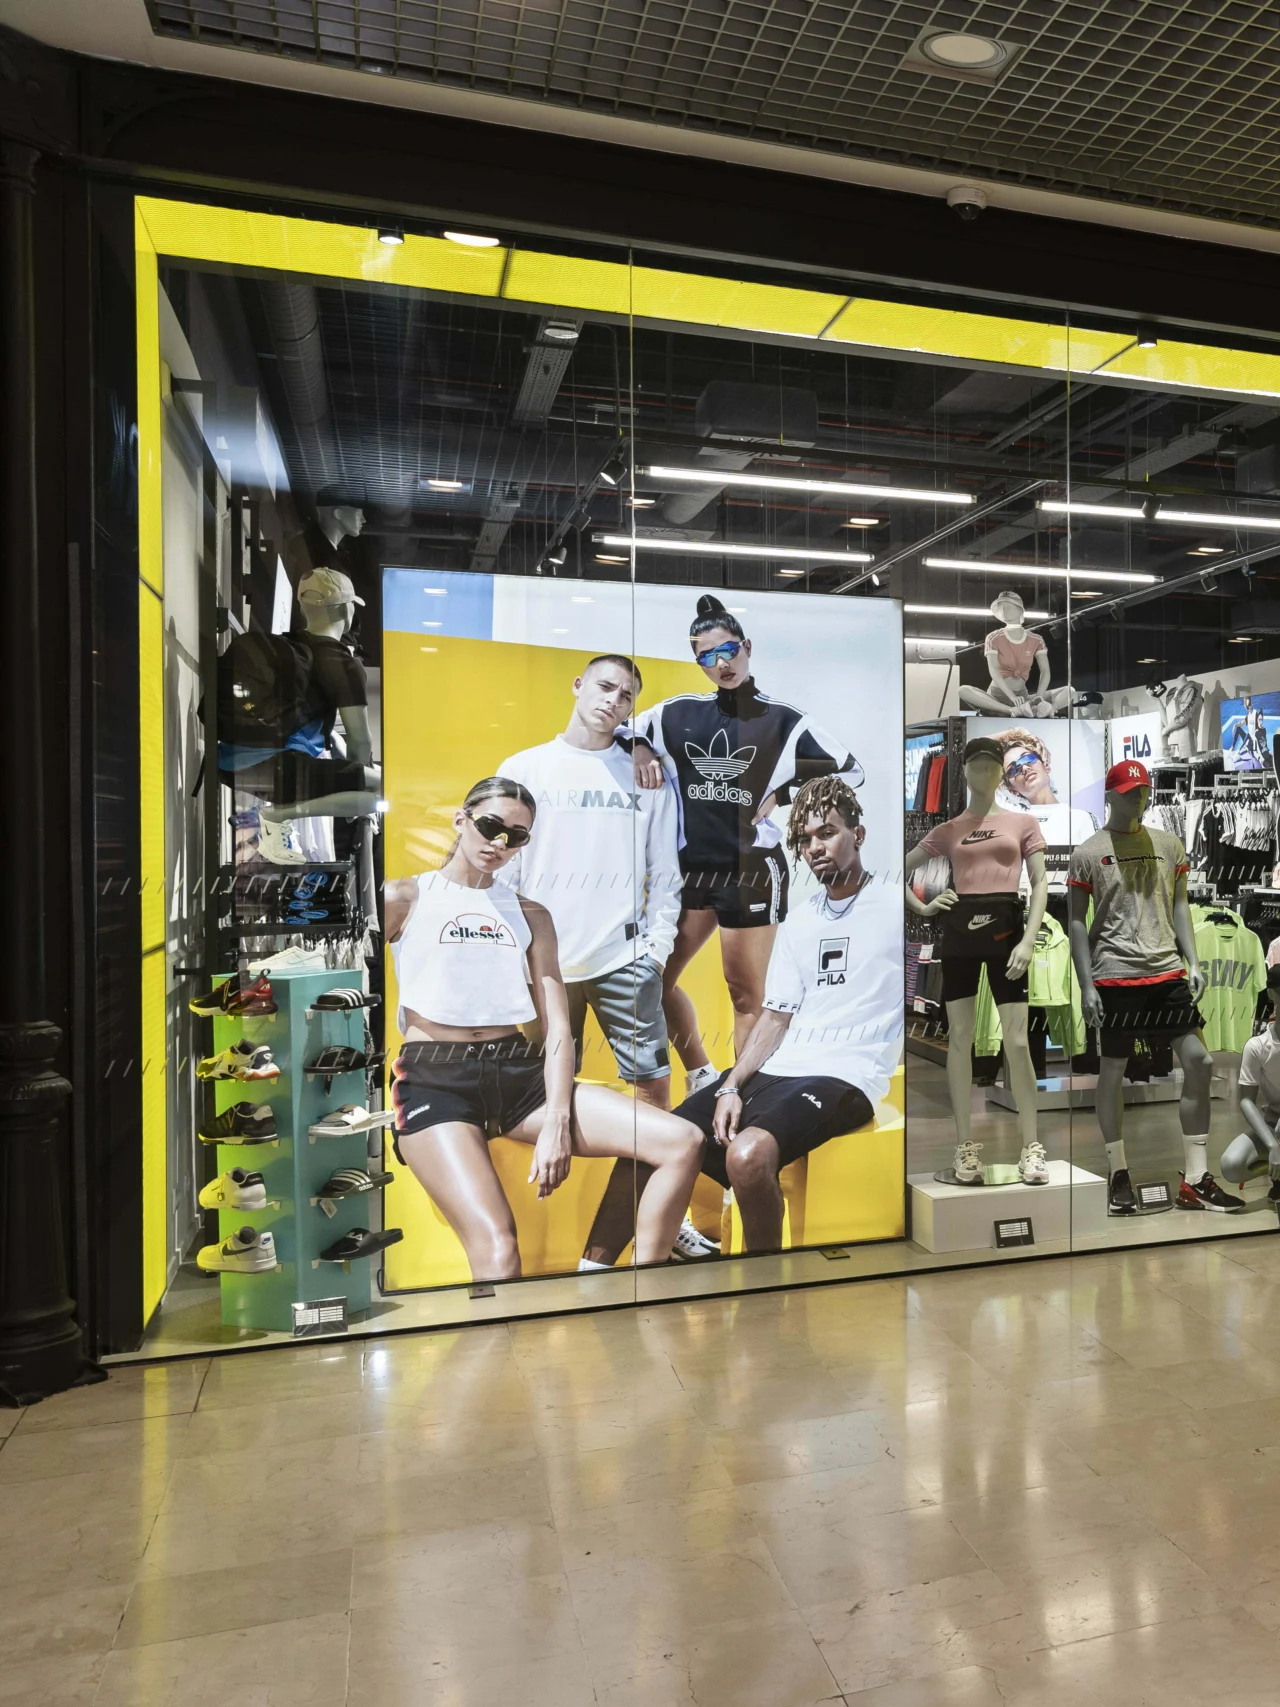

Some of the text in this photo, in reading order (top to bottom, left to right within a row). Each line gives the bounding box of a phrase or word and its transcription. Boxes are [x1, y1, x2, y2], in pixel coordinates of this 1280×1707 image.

[1123, 733, 1152, 760] FILA
[688, 781, 753, 806] adidas
[969, 829, 996, 839] NIKE
[972, 914, 992, 924] NIKE
[449, 926, 504, 940] ellesse
[817, 973, 846, 987] FILA
[802, 1093, 822, 1108] FILA
